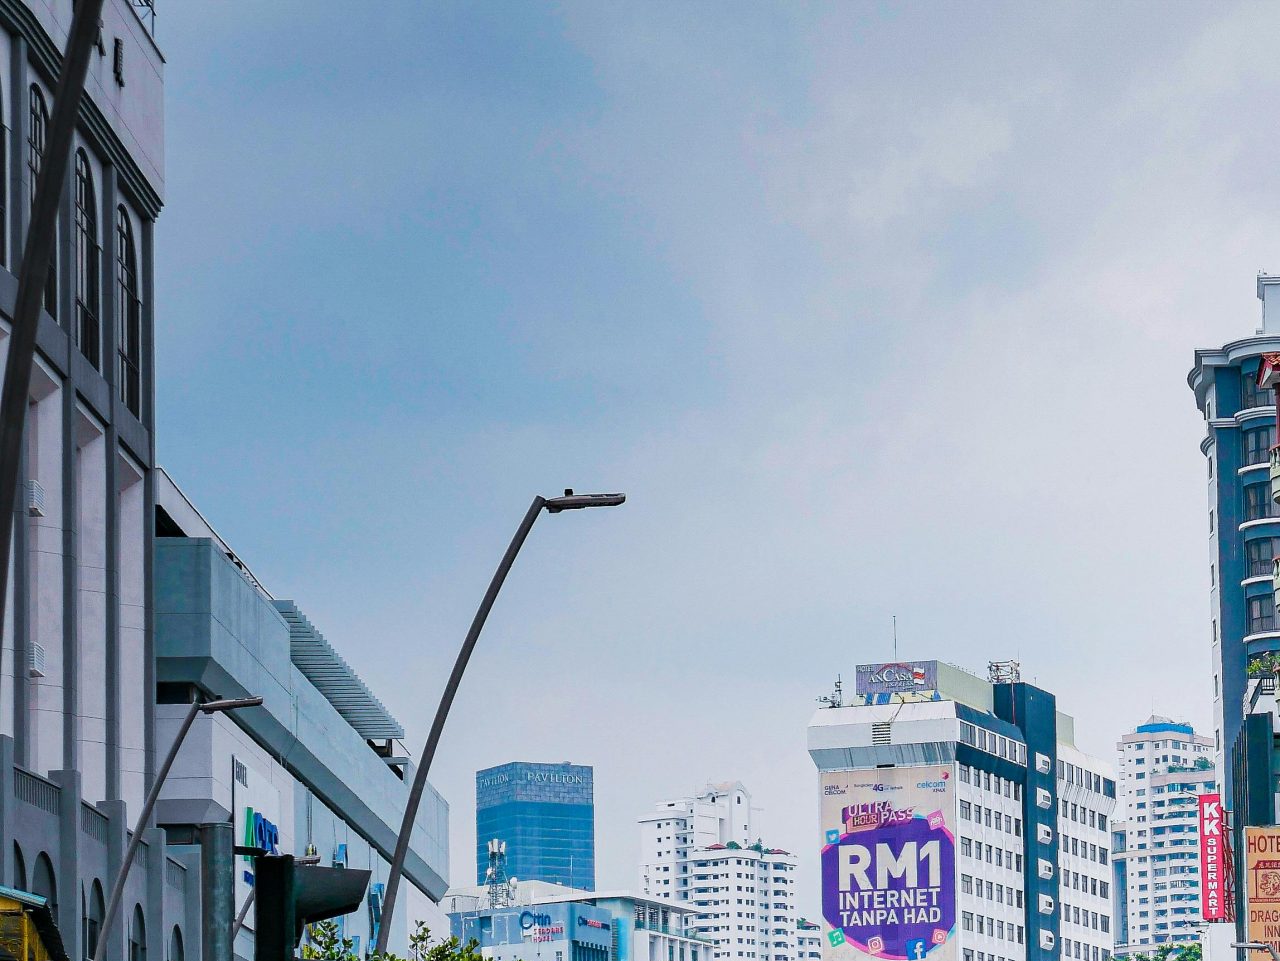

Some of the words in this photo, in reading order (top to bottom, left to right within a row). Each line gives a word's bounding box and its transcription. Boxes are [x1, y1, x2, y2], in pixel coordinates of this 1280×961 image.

[527, 771, 583, 784] PAVILION
[872, 783, 884, 792] 4G
[848, 801, 893, 817] ULTRA
[881, 807, 914, 824] PASS
[853, 814, 878, 826] HOUR
[838, 839, 942, 891] RM1
[838, 887, 941, 911] INTERNET
[840, 908, 900, 928] TANPA
[904, 906, 942, 925] HAD
[1264, 924, 1280, 938] INN
